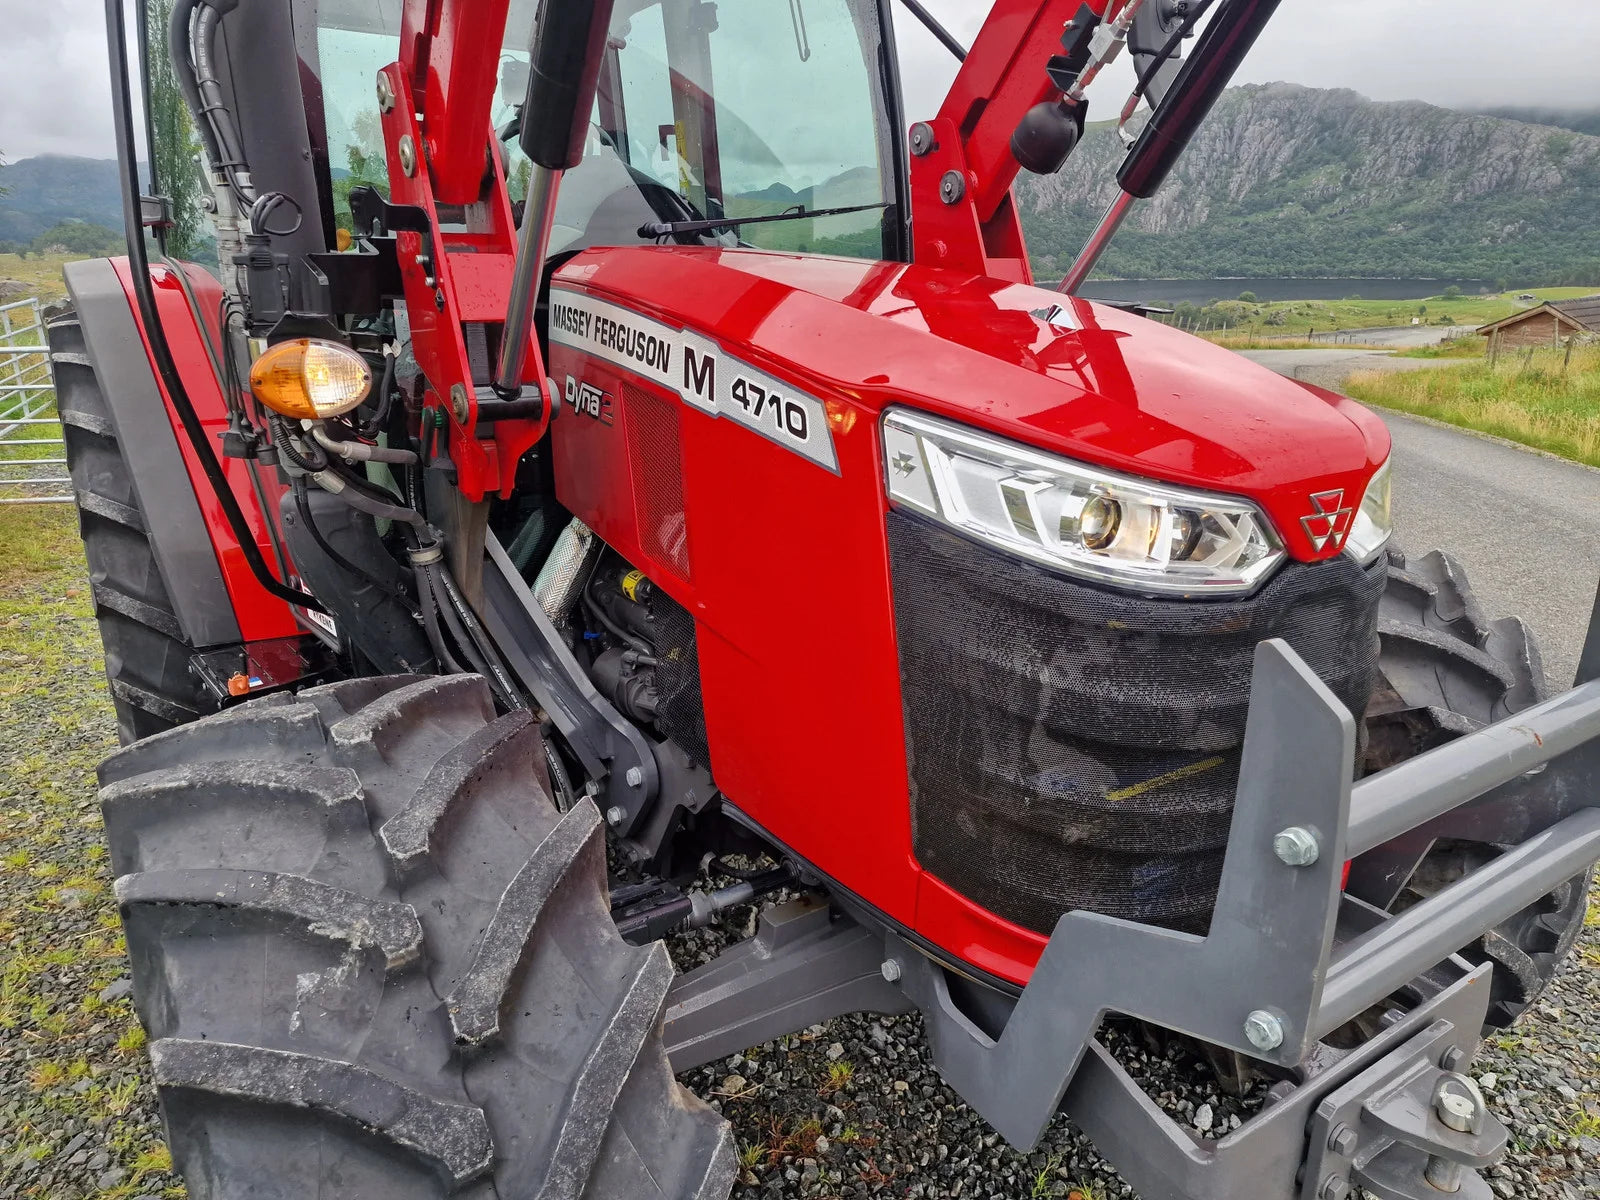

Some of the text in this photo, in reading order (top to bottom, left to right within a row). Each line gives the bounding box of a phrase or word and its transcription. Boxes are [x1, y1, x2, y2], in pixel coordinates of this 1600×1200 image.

[553, 303, 671, 374] MASSEY FERGUSON
[683, 345, 808, 440] M 4710
